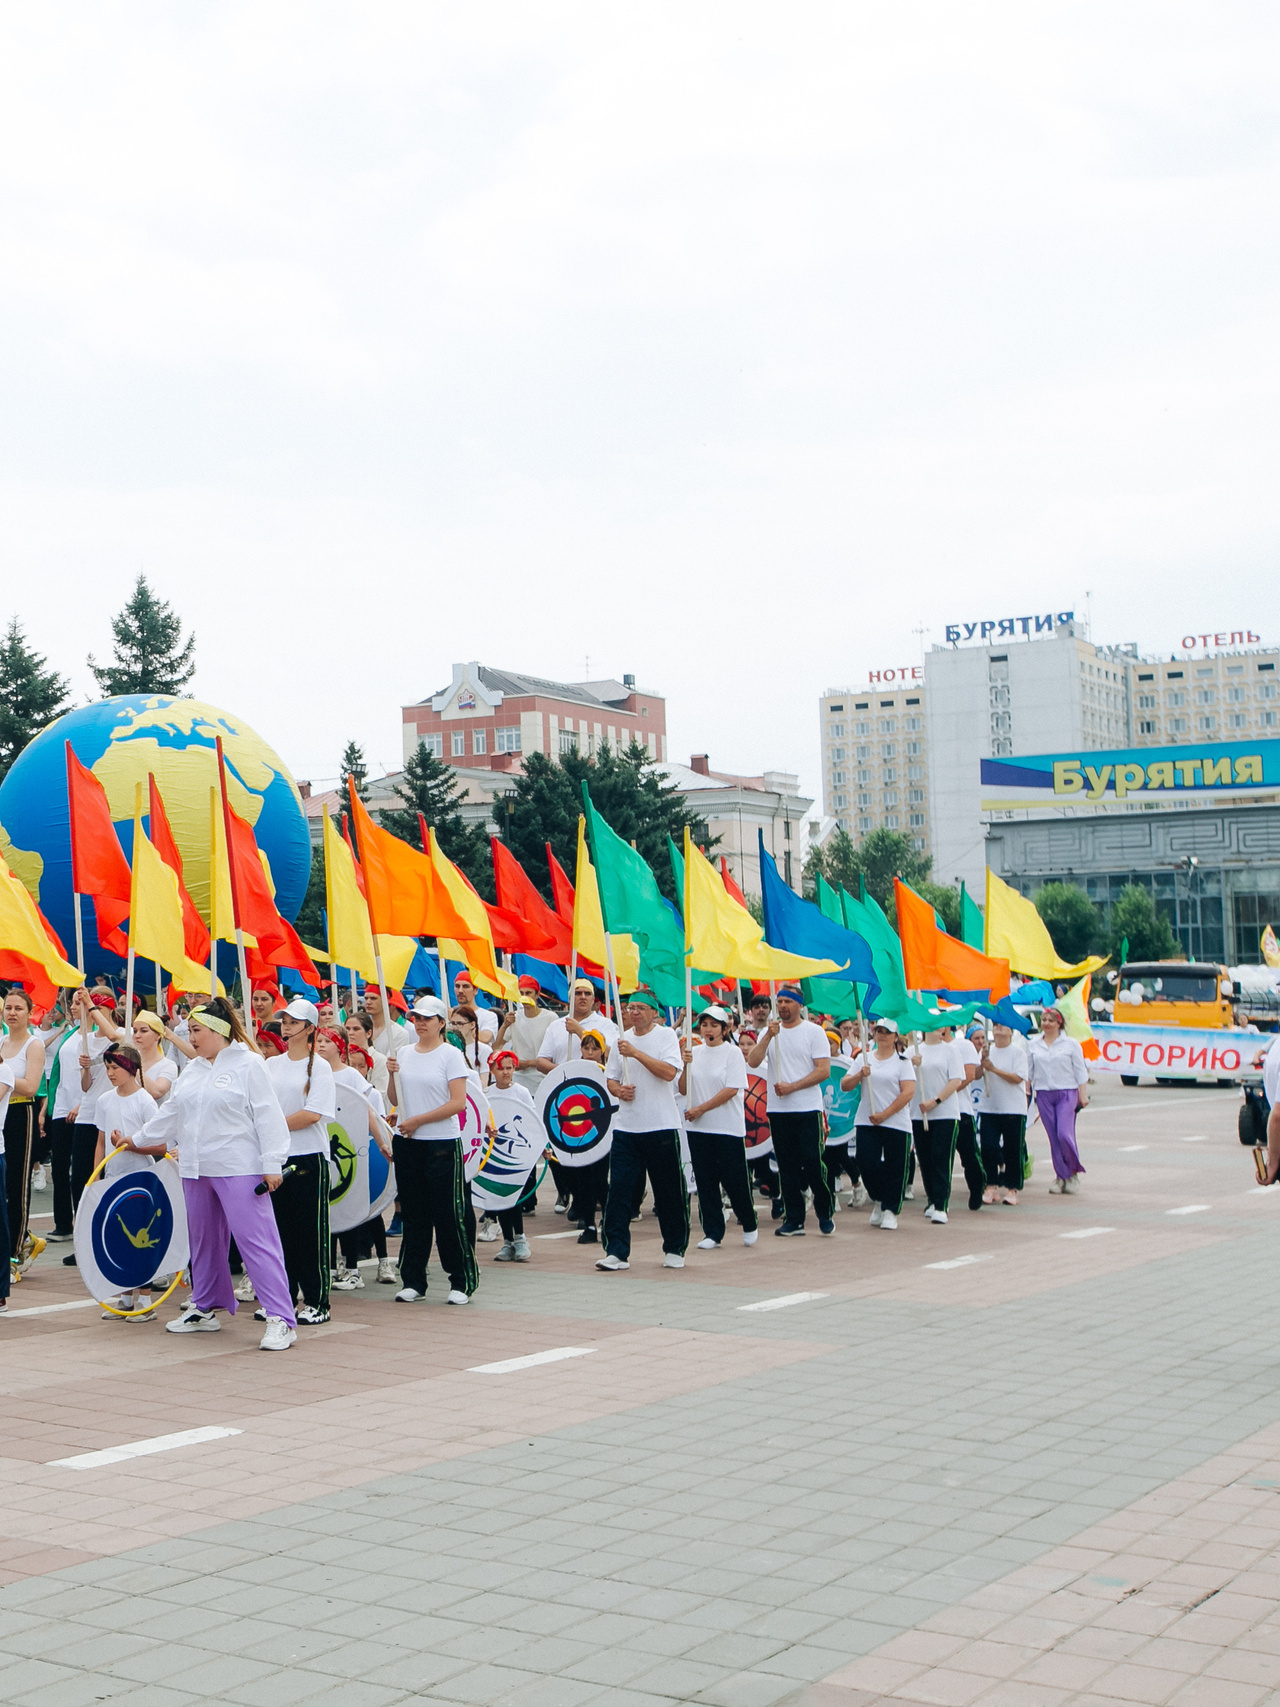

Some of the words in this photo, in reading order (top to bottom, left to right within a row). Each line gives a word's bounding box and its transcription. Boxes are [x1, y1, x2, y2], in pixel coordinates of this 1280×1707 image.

[945, 611, 1074, 642] БУРЯТИЯ
[1181, 630, 1261, 649] ОТЕЛЬ
[868, 666, 924, 683] HOTE
[1052, 754, 1264, 800] Бурятия
